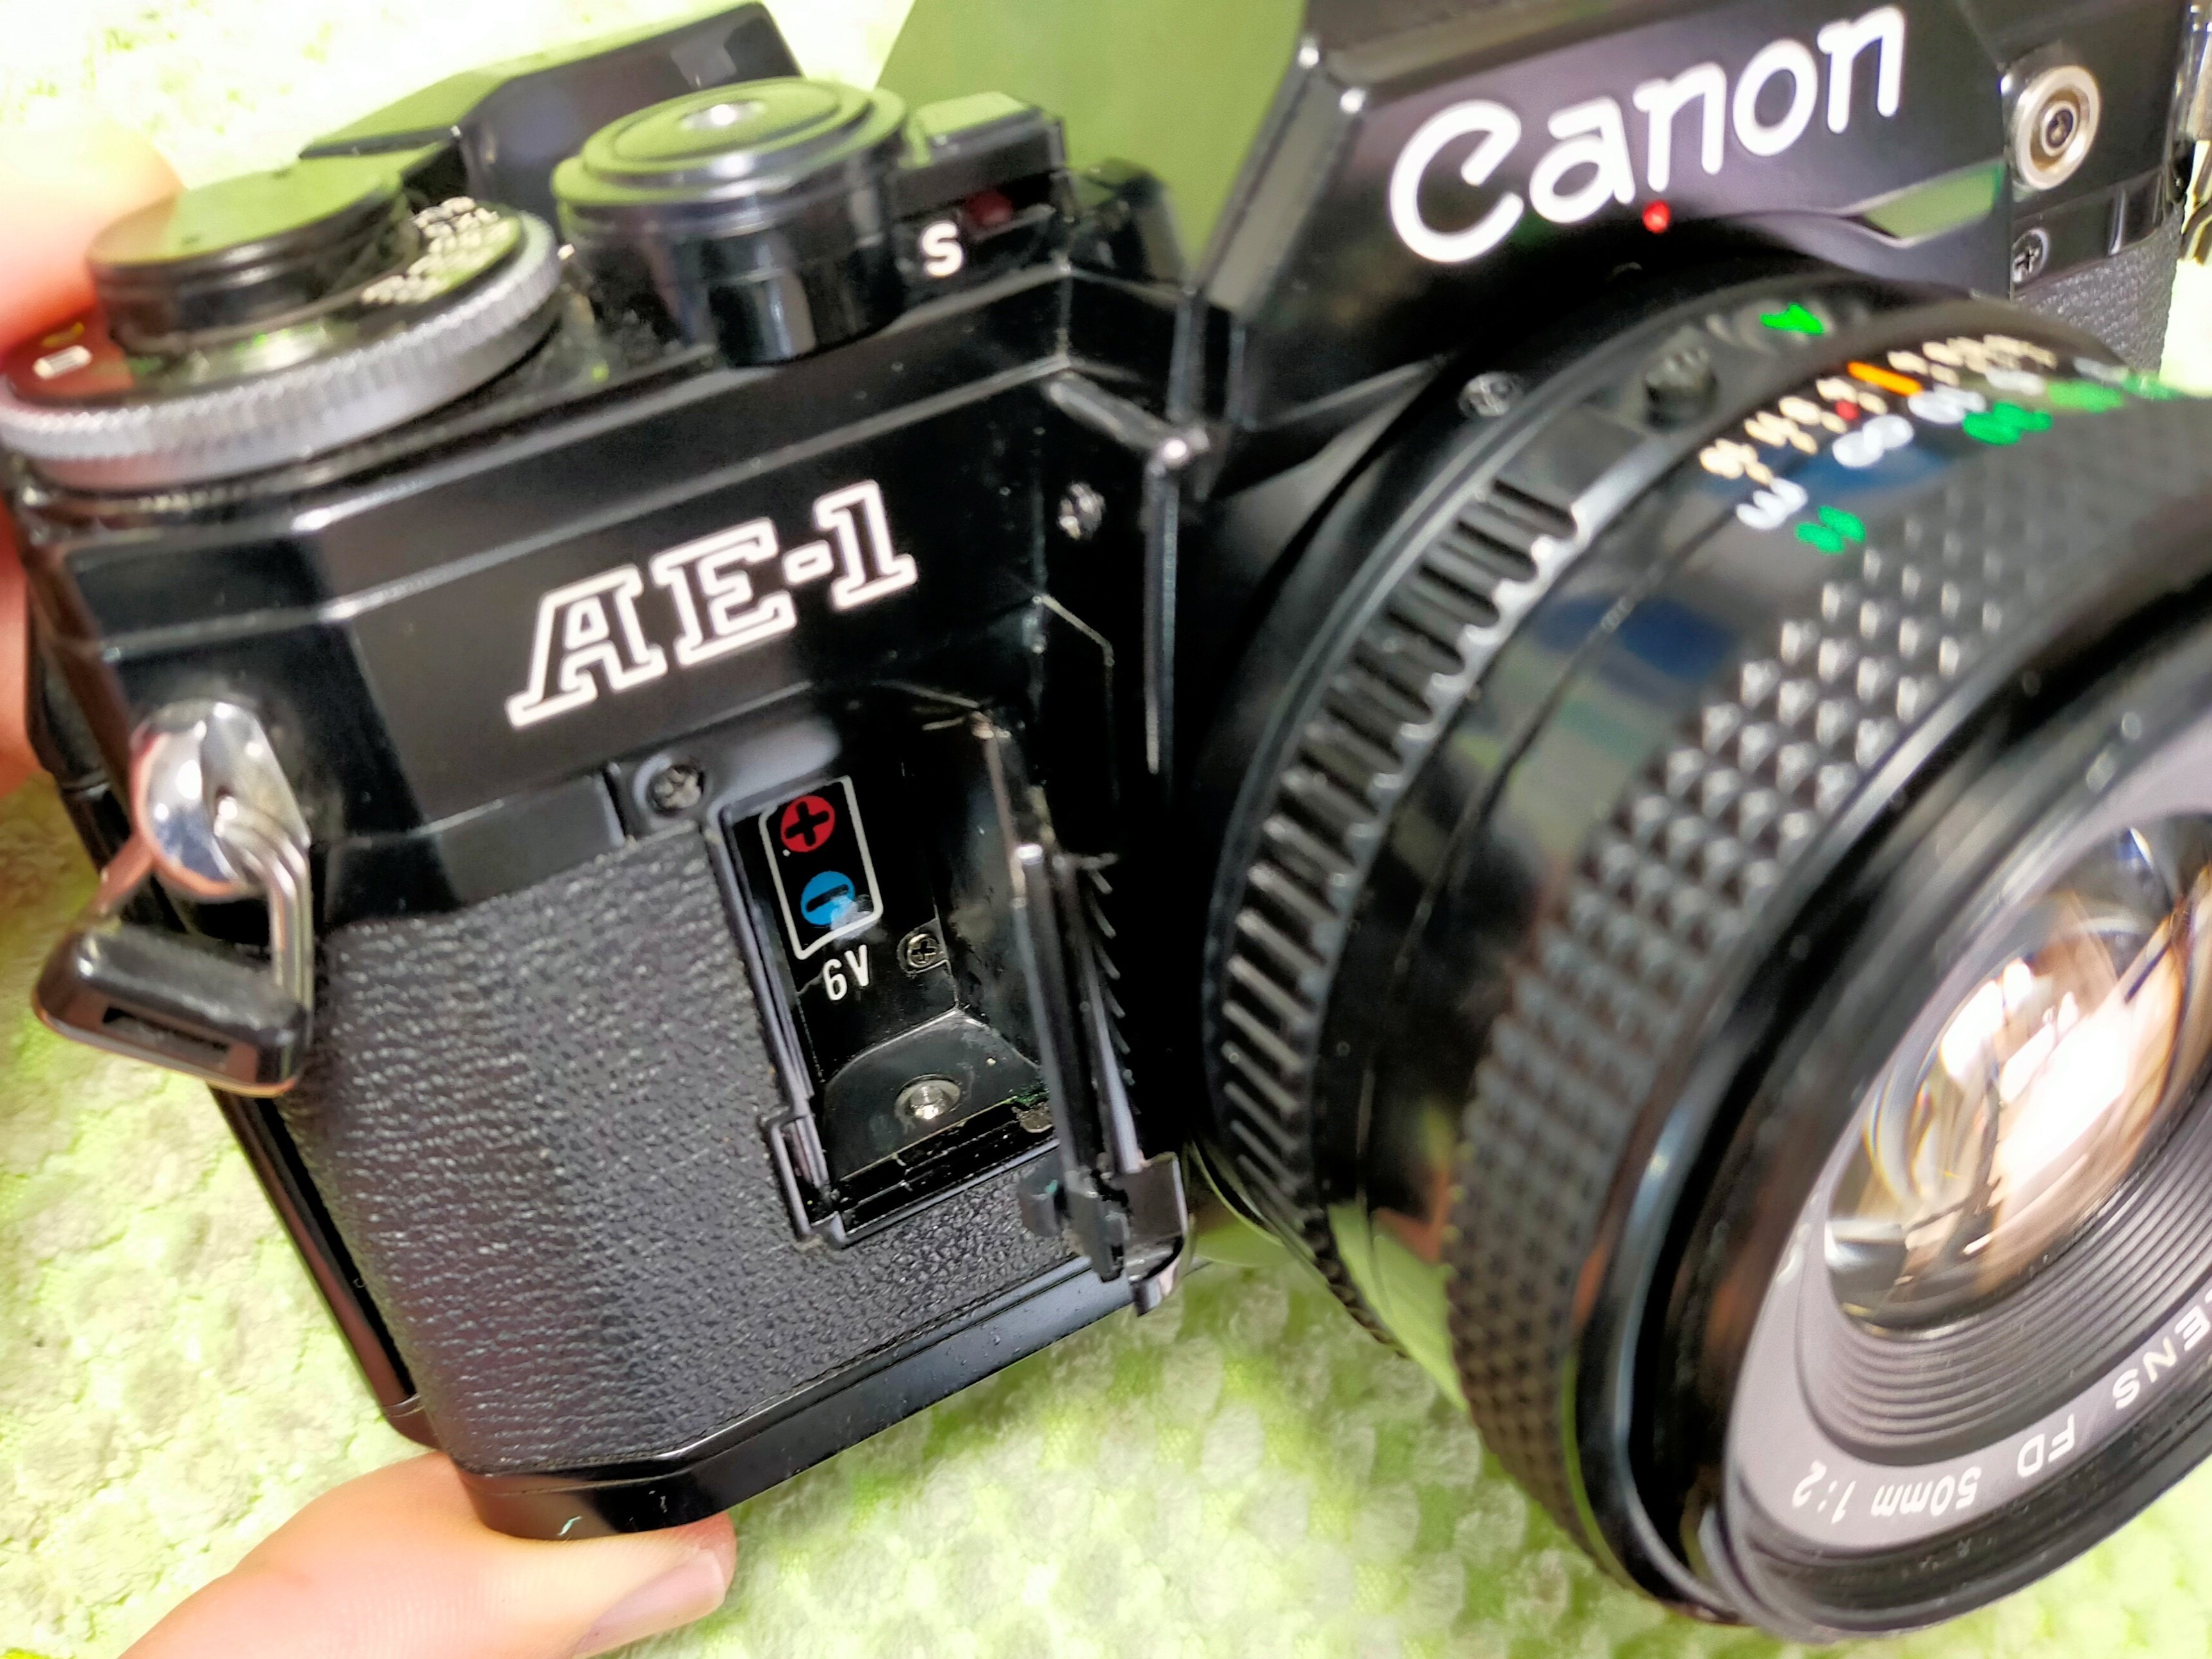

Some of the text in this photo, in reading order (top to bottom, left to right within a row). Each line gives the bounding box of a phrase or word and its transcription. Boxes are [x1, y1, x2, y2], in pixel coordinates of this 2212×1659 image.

[921, 221, 963, 277] S
[1390, 5, 1905, 263] Canon
[506, 479, 918, 727] AE-1
[823, 945, 870, 1001] 6V
[1792, 1288, 2212, 1525] ENS FD 50mm 1:2
